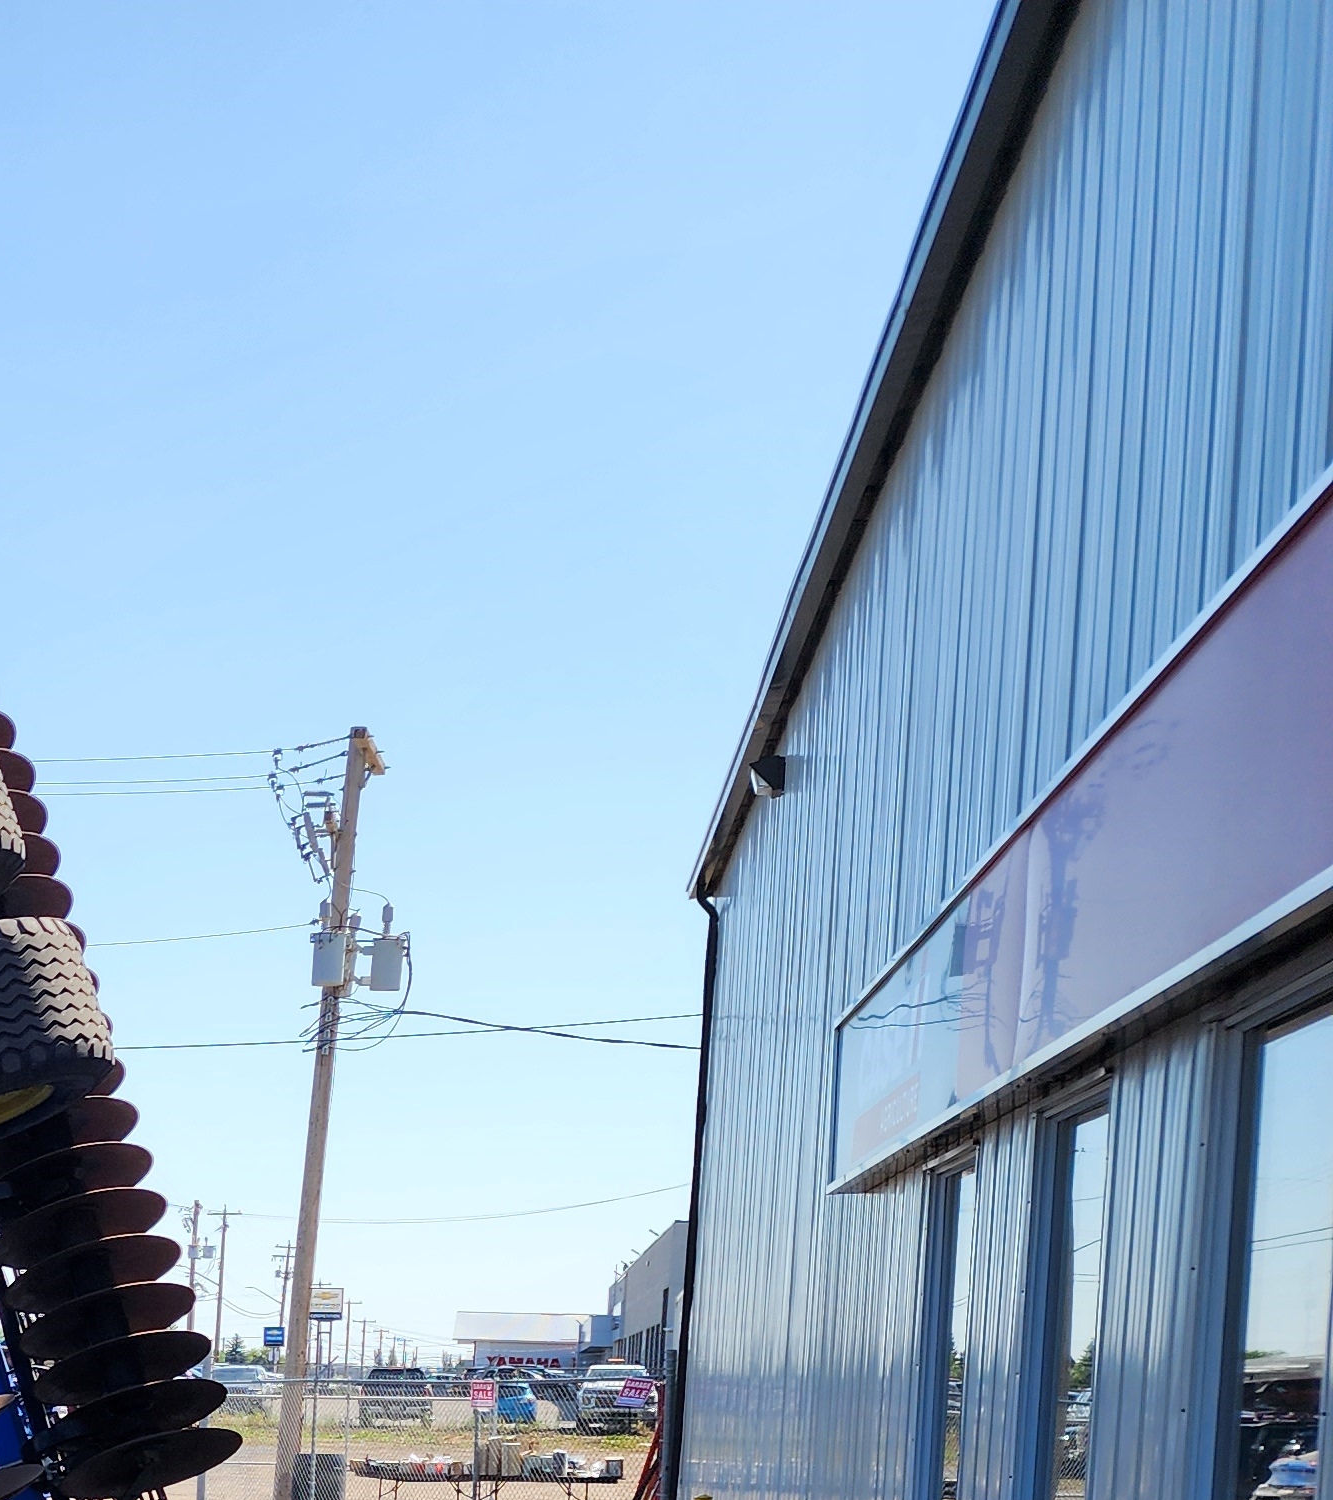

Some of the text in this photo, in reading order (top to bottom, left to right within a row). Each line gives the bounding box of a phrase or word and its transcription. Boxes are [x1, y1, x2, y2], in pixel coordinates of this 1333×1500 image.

[486, 1356, 562, 1368] YAMAHA
[473, 1390, 493, 1400] SALE
[622, 1388, 649, 1399] SALE
